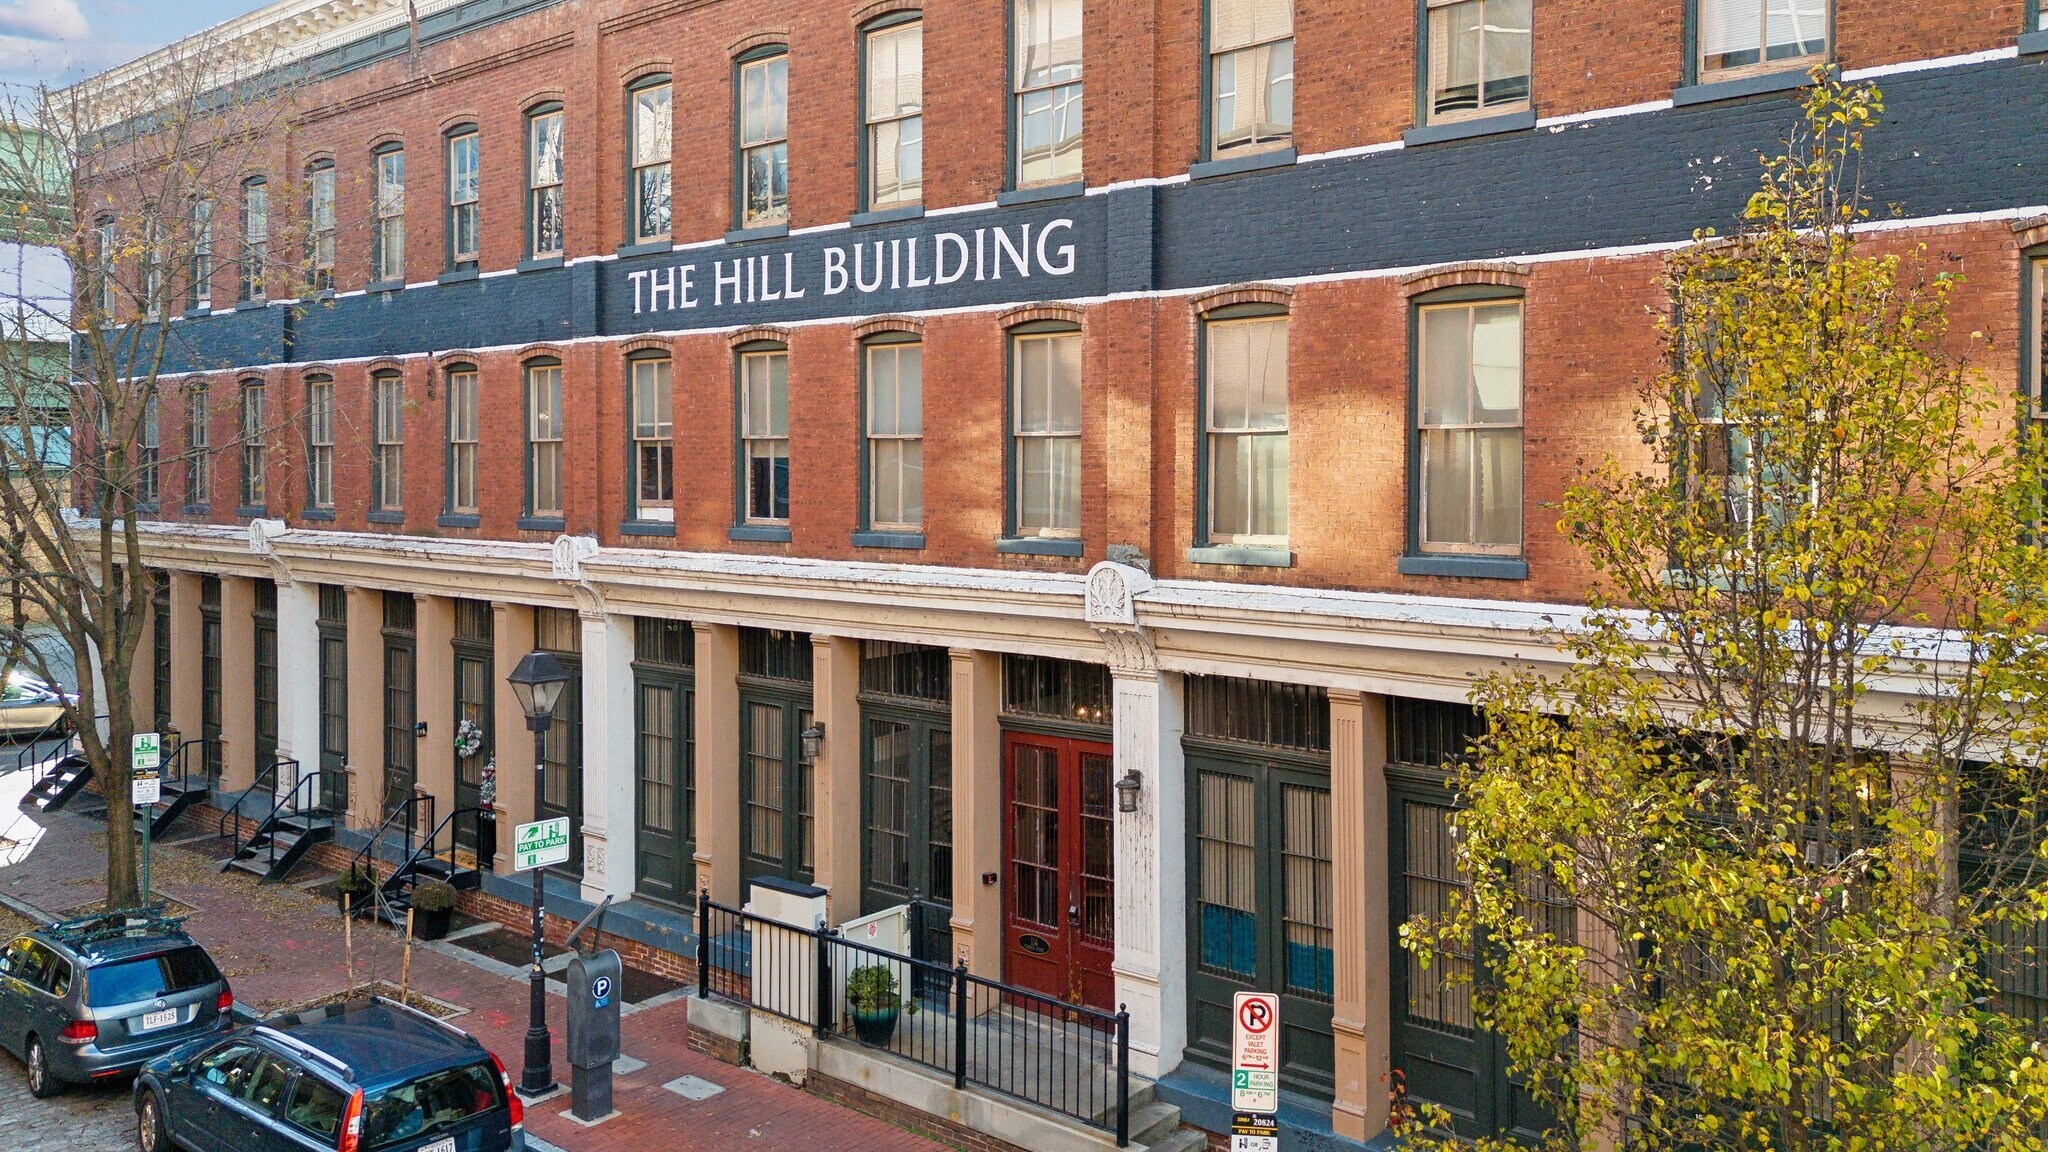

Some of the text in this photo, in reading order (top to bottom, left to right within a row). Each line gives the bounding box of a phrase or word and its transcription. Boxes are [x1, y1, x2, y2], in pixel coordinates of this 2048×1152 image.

[627, 218, 1075, 314] THE HILL BUILDING
[519, 836, 566, 852] PAY TO PARK
[597, 980, 608, 996] P
[1244, 1047, 1267, 1055] PARKING
[1236, 1072, 1247, 1086] 2
[1250, 1080, 1274, 1088] PARKING
[1253, 1118, 1275, 1127] 20824
